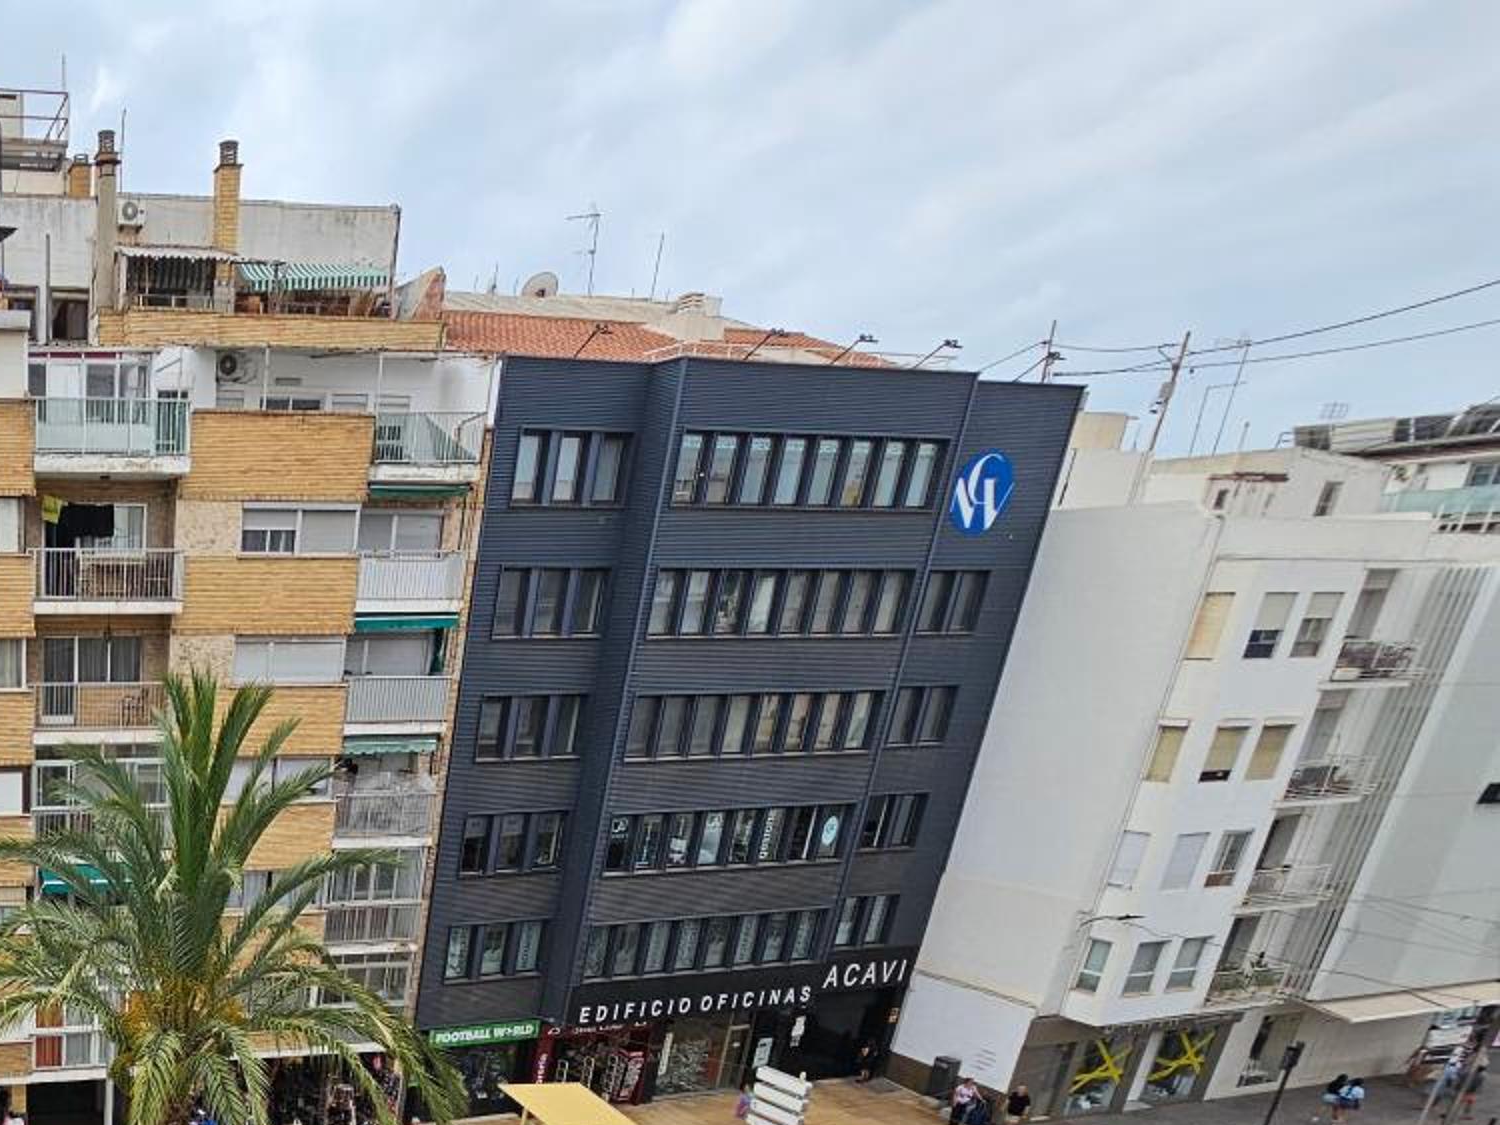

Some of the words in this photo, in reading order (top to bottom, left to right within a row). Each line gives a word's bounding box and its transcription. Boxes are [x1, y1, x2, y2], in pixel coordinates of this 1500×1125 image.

[579, 996, 692, 1024] EDIFICIO
[700, 985, 812, 1012] OFICINAS
[821, 959, 908, 990] ACAVI
[435, 1027, 491, 1044] FOOTBALL
